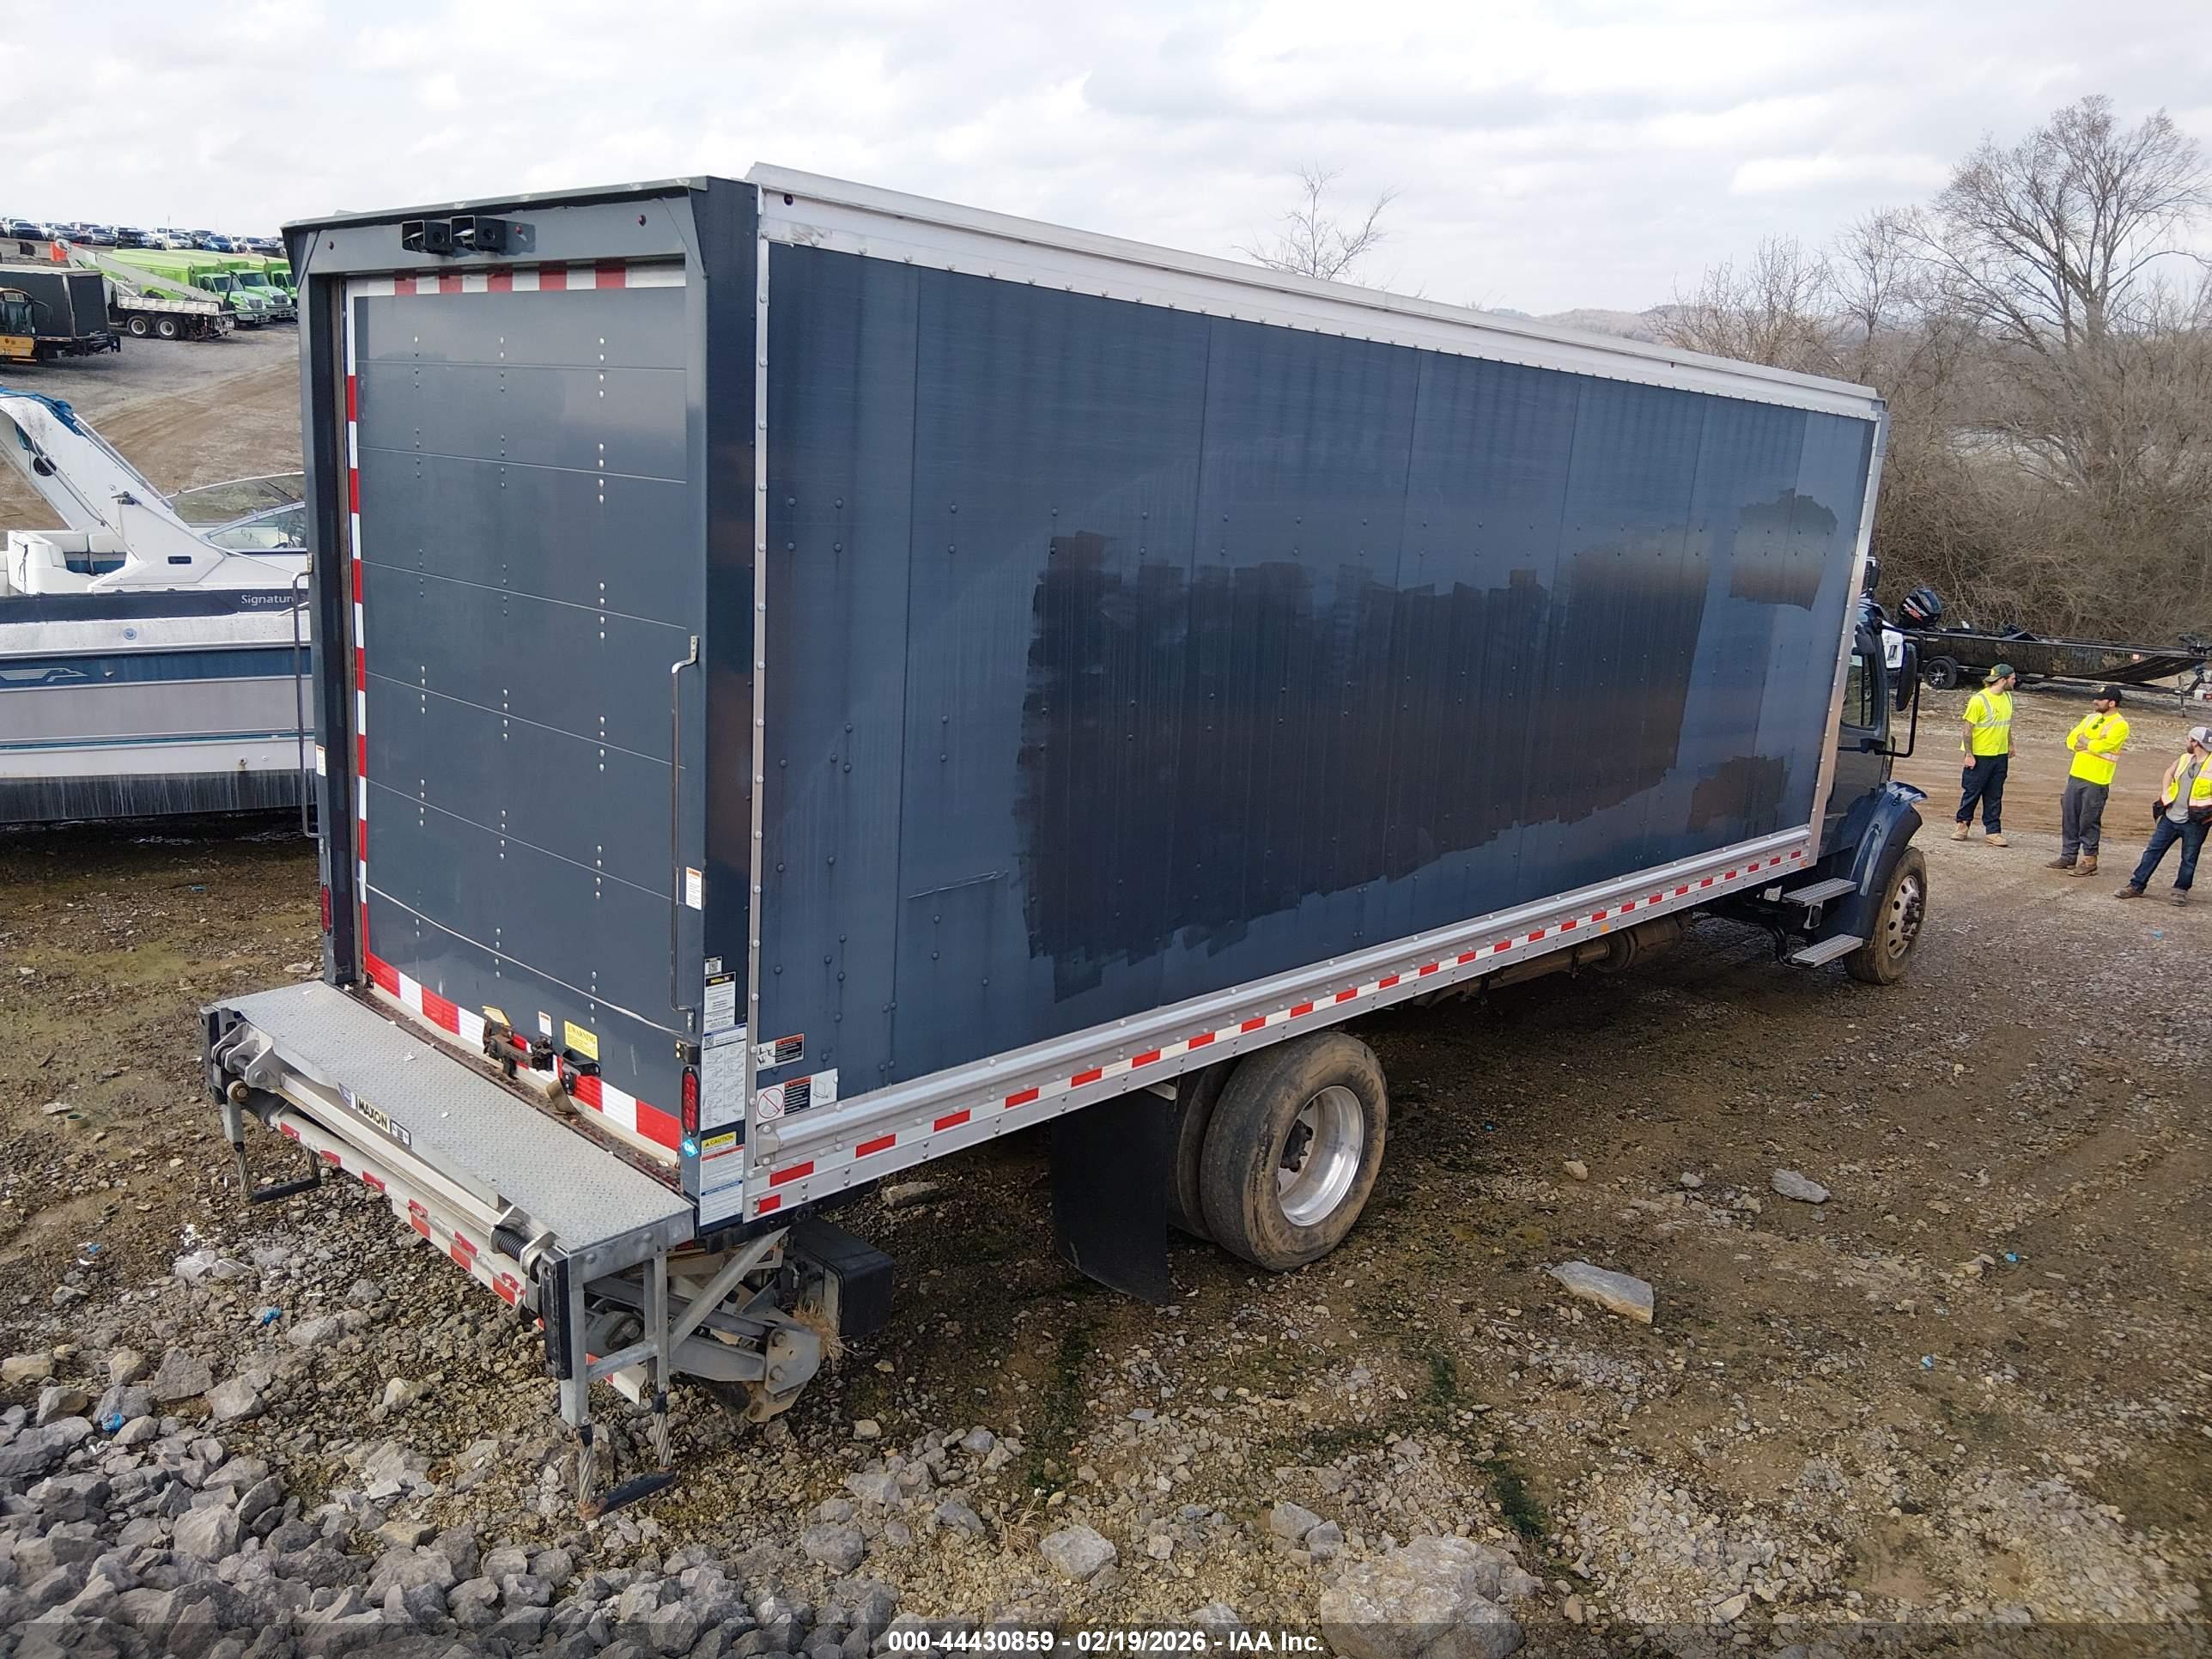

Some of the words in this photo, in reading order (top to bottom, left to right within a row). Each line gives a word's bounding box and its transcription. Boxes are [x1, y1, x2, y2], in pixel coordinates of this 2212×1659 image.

[240, 593, 295, 606] Signatur
[359, 1098, 388, 1130] MAXON
[710, 1133, 734, 1146] CAUTION
